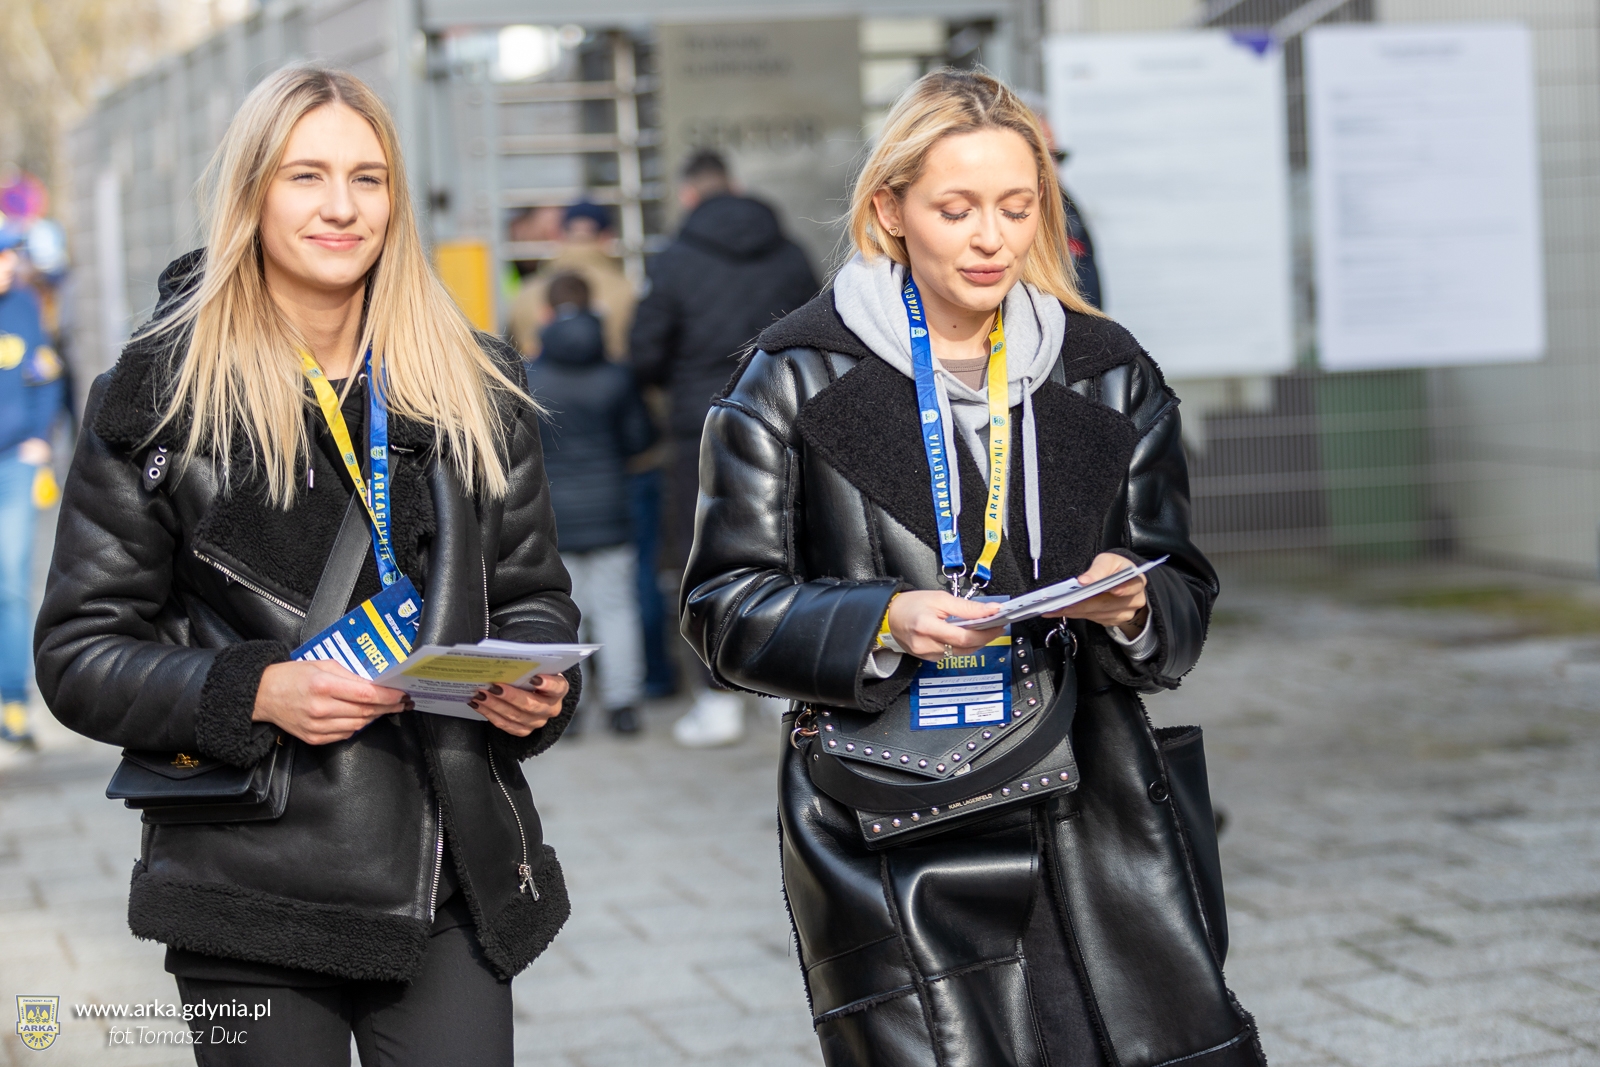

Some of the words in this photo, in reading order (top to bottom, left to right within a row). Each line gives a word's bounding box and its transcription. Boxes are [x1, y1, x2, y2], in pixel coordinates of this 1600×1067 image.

[928, 433, 952, 518] ARKAGDYNIA
[989, 439, 1003, 520] ARKAGDYNIA
[356, 632, 389, 674] STREFA
[936, 655, 978, 670] STREFA
[948, 802, 963, 810] KARL
[962, 793, 993, 806] LAGERFELD
